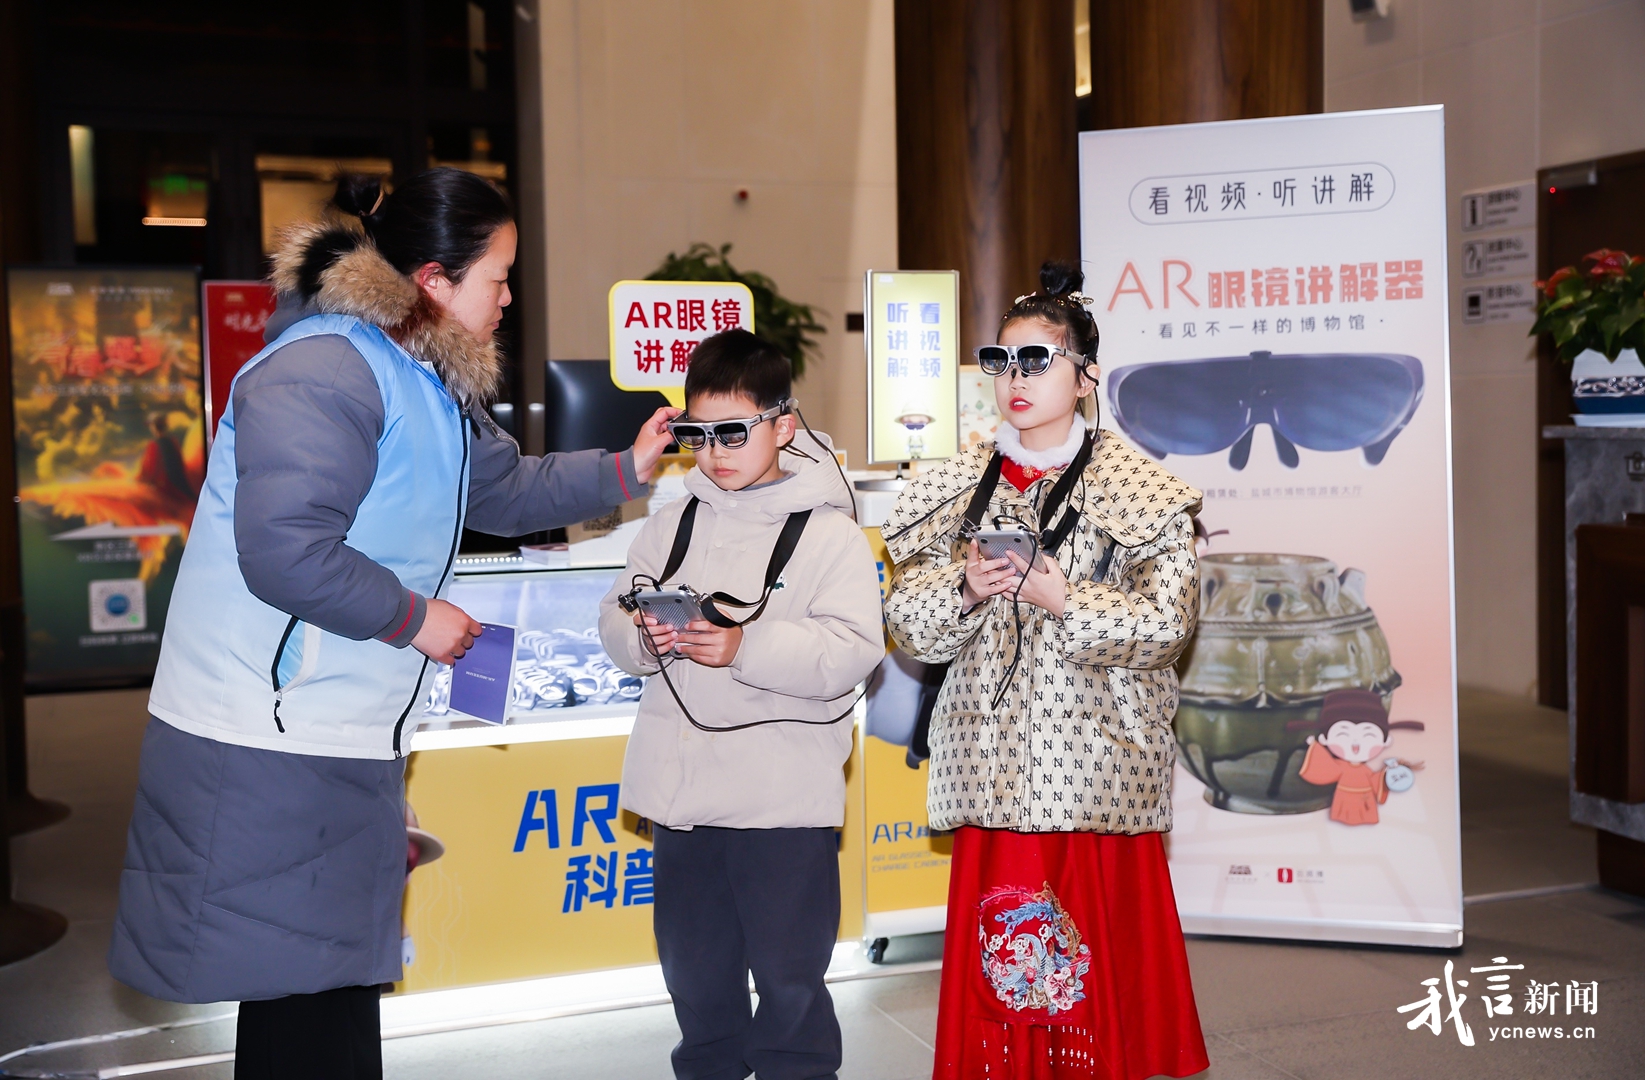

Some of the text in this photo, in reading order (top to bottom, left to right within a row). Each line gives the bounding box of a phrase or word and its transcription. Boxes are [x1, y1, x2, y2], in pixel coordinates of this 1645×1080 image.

[624, 299, 743, 332] AR眼镜
[886, 301, 910, 379] 听讲解
[919, 301, 942, 379] 看视频
